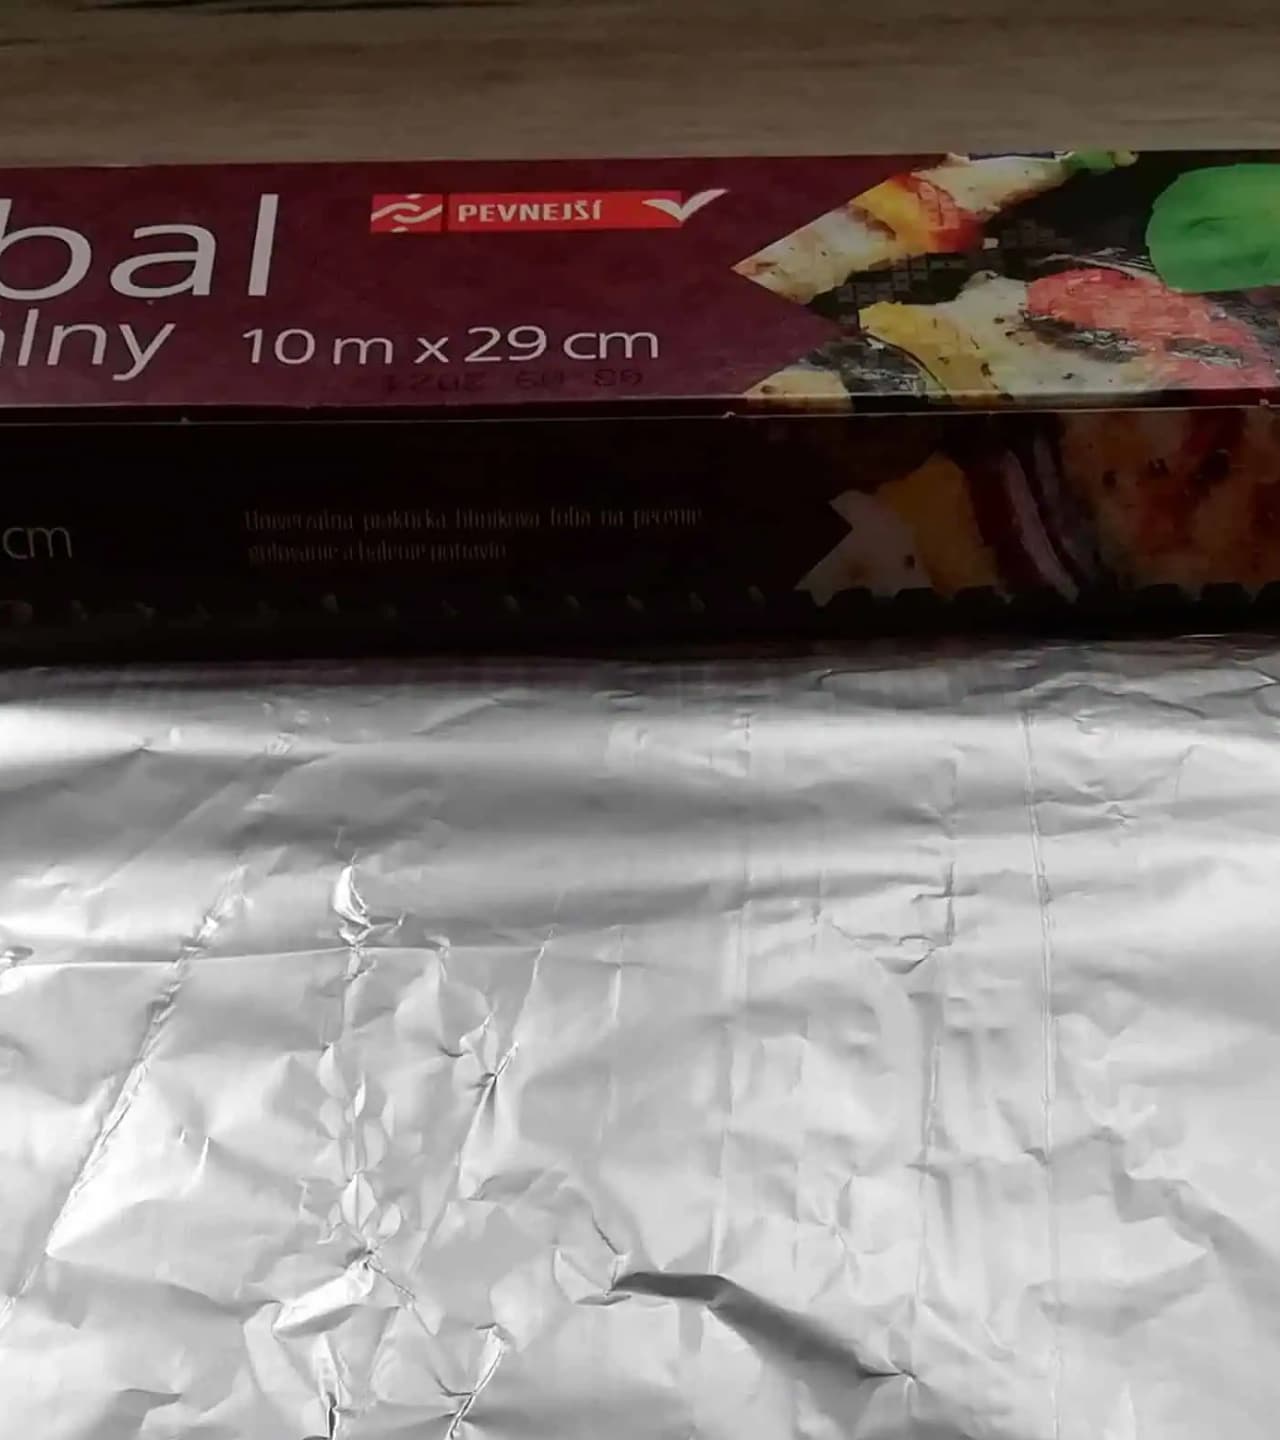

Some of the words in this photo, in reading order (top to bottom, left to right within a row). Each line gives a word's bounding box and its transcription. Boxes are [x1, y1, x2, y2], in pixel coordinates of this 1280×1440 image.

[458, 199, 603, 223] PEVNEJŠÍ
[241, 327, 317, 366] 10
[332, 337, 394, 366] m
[413, 336, 449, 365] x
[464, 325, 547, 363] 29
[563, 331, 659, 361] cm
[2, 526, 73, 560] cm
